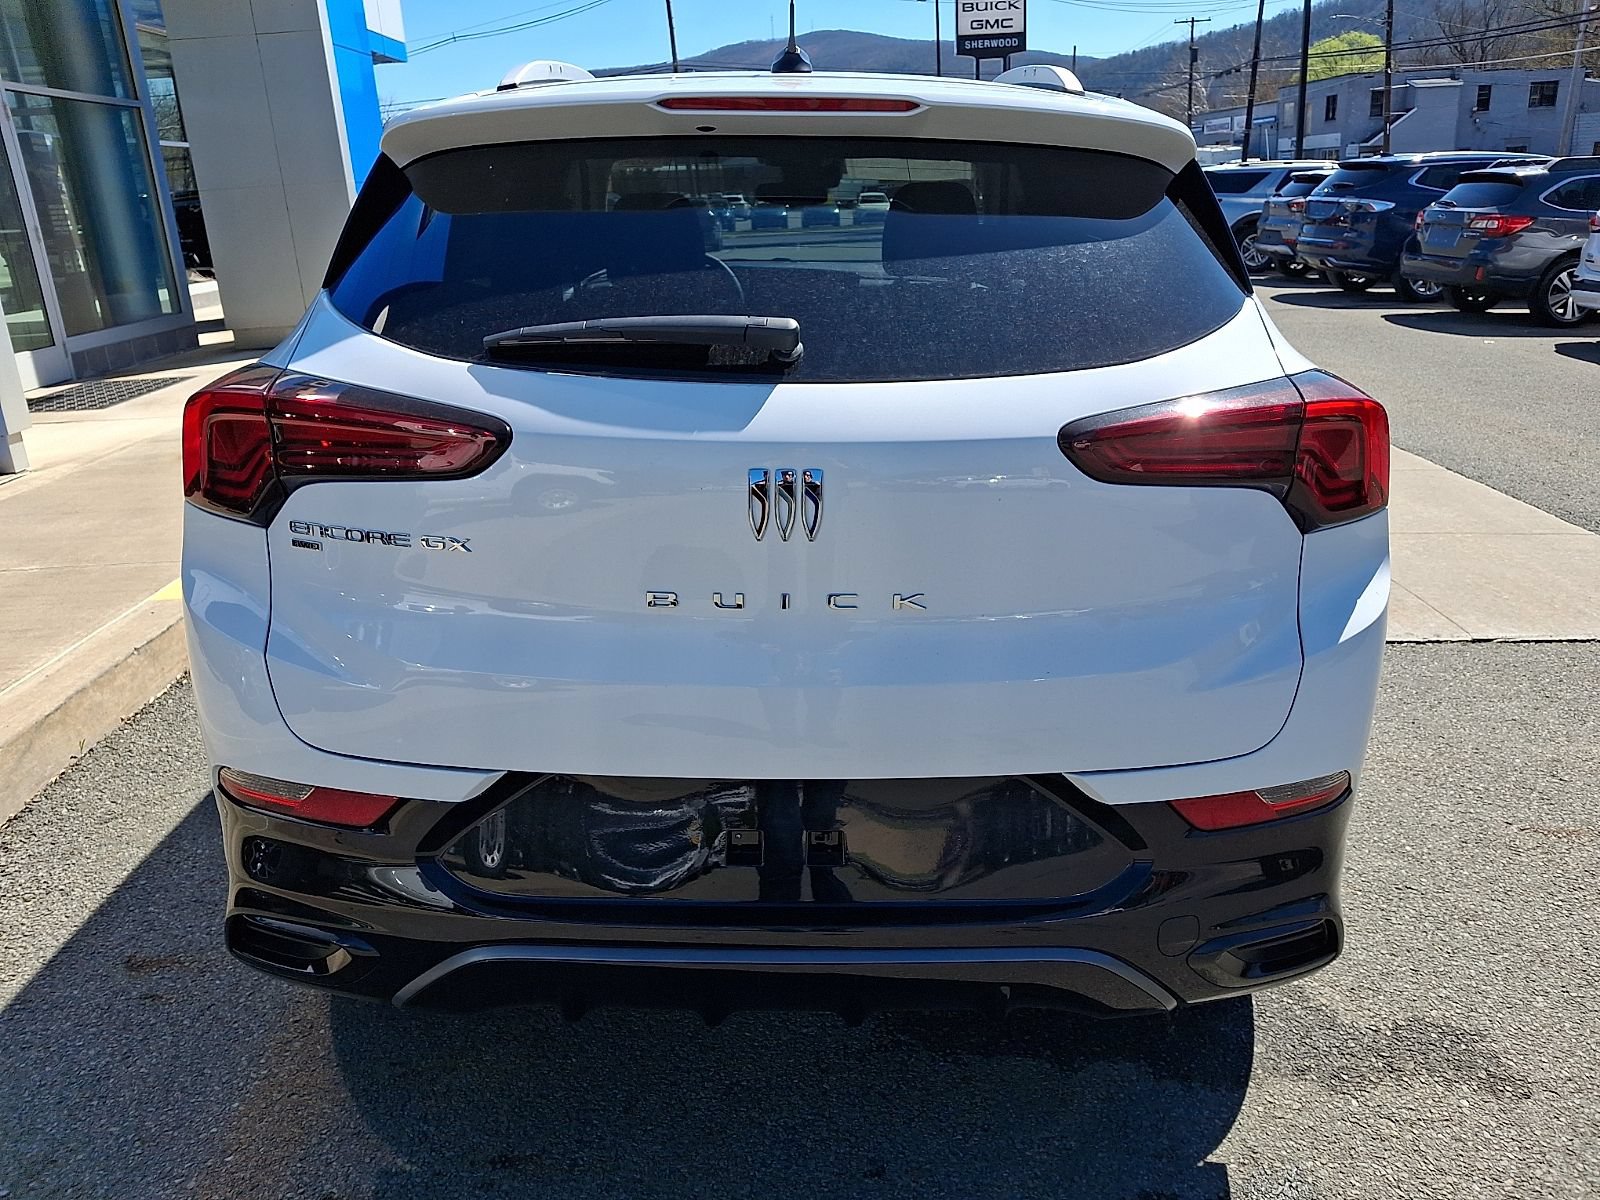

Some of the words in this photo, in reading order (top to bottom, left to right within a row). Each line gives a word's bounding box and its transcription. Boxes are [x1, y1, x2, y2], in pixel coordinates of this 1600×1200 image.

[962, 1, 1021, 12] BUICK
[970, 18, 1014, 30] GMC
[965, 38, 1019, 49] SHERWOOD
[289, 520, 412, 548] ENCORE
[420, 534, 473, 552] GX
[646, 591, 927, 610] BUICK
